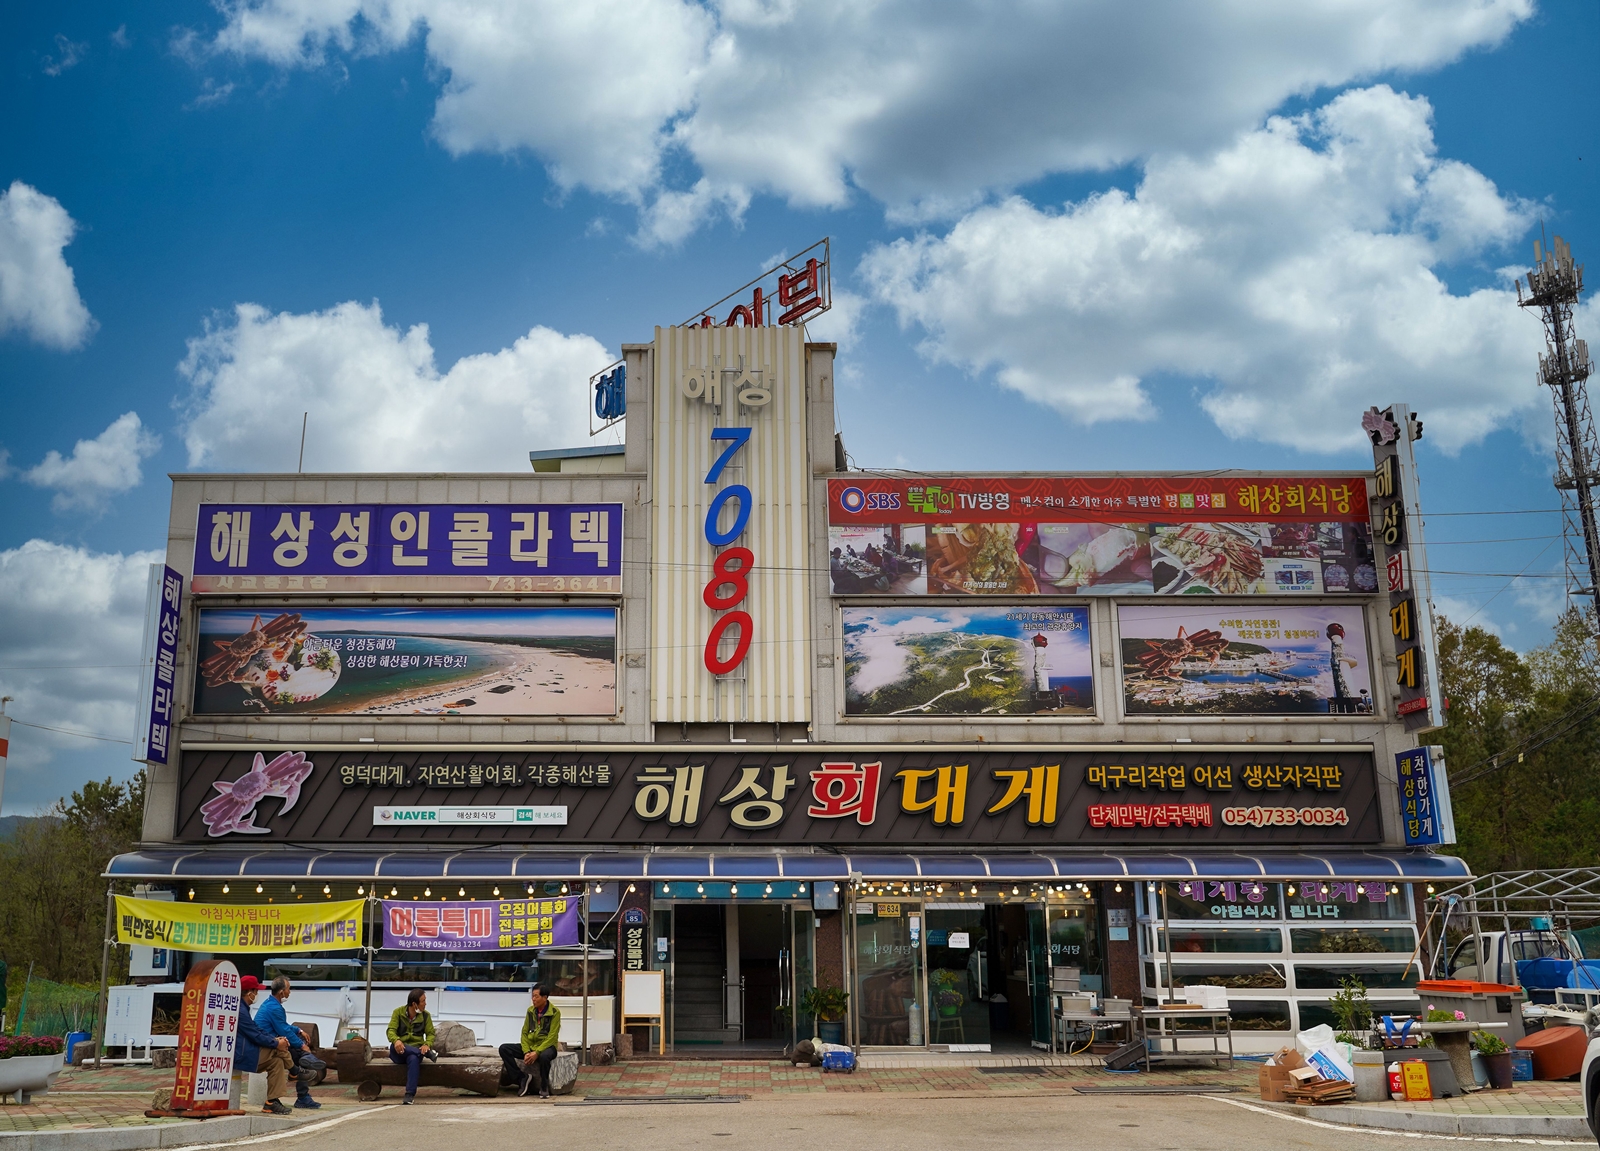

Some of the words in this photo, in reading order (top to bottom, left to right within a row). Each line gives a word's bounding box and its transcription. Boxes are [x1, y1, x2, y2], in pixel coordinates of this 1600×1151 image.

[867, 492, 901, 510] SBS
[906, 487, 955, 513] 투데이
[958, 492, 1010, 510] TV방영
[1068, 496, 1101, 508] 소개한
[1103, 497, 1123, 507] 아주
[1126, 496, 1161, 508] 특별한
[1165, 493, 1227, 509] 명품맛집
[1237, 484, 1353, 515] 해상회식당
[703, 427, 755, 675] 7080
[1375, 455, 1417, 689] 해상회대게
[486, 576, 616, 592] 733-3641
[302, 638, 343, 651] 아름다운
[346, 638, 397, 651] 청정동해와
[152, 576, 181, 759] 해상콜라텍
[346, 655, 377, 668] 싱싱한
[379, 655, 420, 668] 해산물이
[422, 655, 468, 668] 가득한곳!
[339, 764, 411, 785] 영덕대게.
[418, 764, 522, 785] 자연산활어회.
[528, 764, 612, 784] 각종해산물
[1088, 765, 1187, 789] 머구리작업
[1193, 765, 1234, 789] 어선
[1243, 765, 1343, 789] 생산자직판
[633, 761, 1061, 827] 해상회대게
[1400, 757, 1420, 839] 해상식당
[1414, 755, 1433, 837] 착한가게
[393, 811, 437, 821] NAVER
[456, 810, 497, 820] 해상회식당
[1089, 804, 1212, 826] 단체민박/전국택배
[1224, 807, 1348, 827] 054)733-0034
[200, 907, 281, 921] 아침식사됩니다
[498, 900, 567, 918] 오징어물회
[886, 903, 899, 913] 634
[1210, 904, 1277, 919] 아침식사
[389, 906, 494, 939] 여름특미
[498, 916, 553, 934] 전복물회
[398, 939, 432, 949] 해상회식당
[432, 940, 448, 949] 054
[448, 940, 463, 949] 733
[463, 940, 482, 949] 1234
[498, 931, 553, 948] 해초물회
[627, 928, 644, 971] 성인콜라
[214, 971, 238, 989] 차림표
[205, 1013, 237, 1033] 해물탕
[175, 988, 203, 1101] 아침식사됩니다
[202, 1034, 235, 1052] 대게탕
[199, 1056, 231, 1074] 된장찌개
[197, 1078, 229, 1095] 김치찌개
